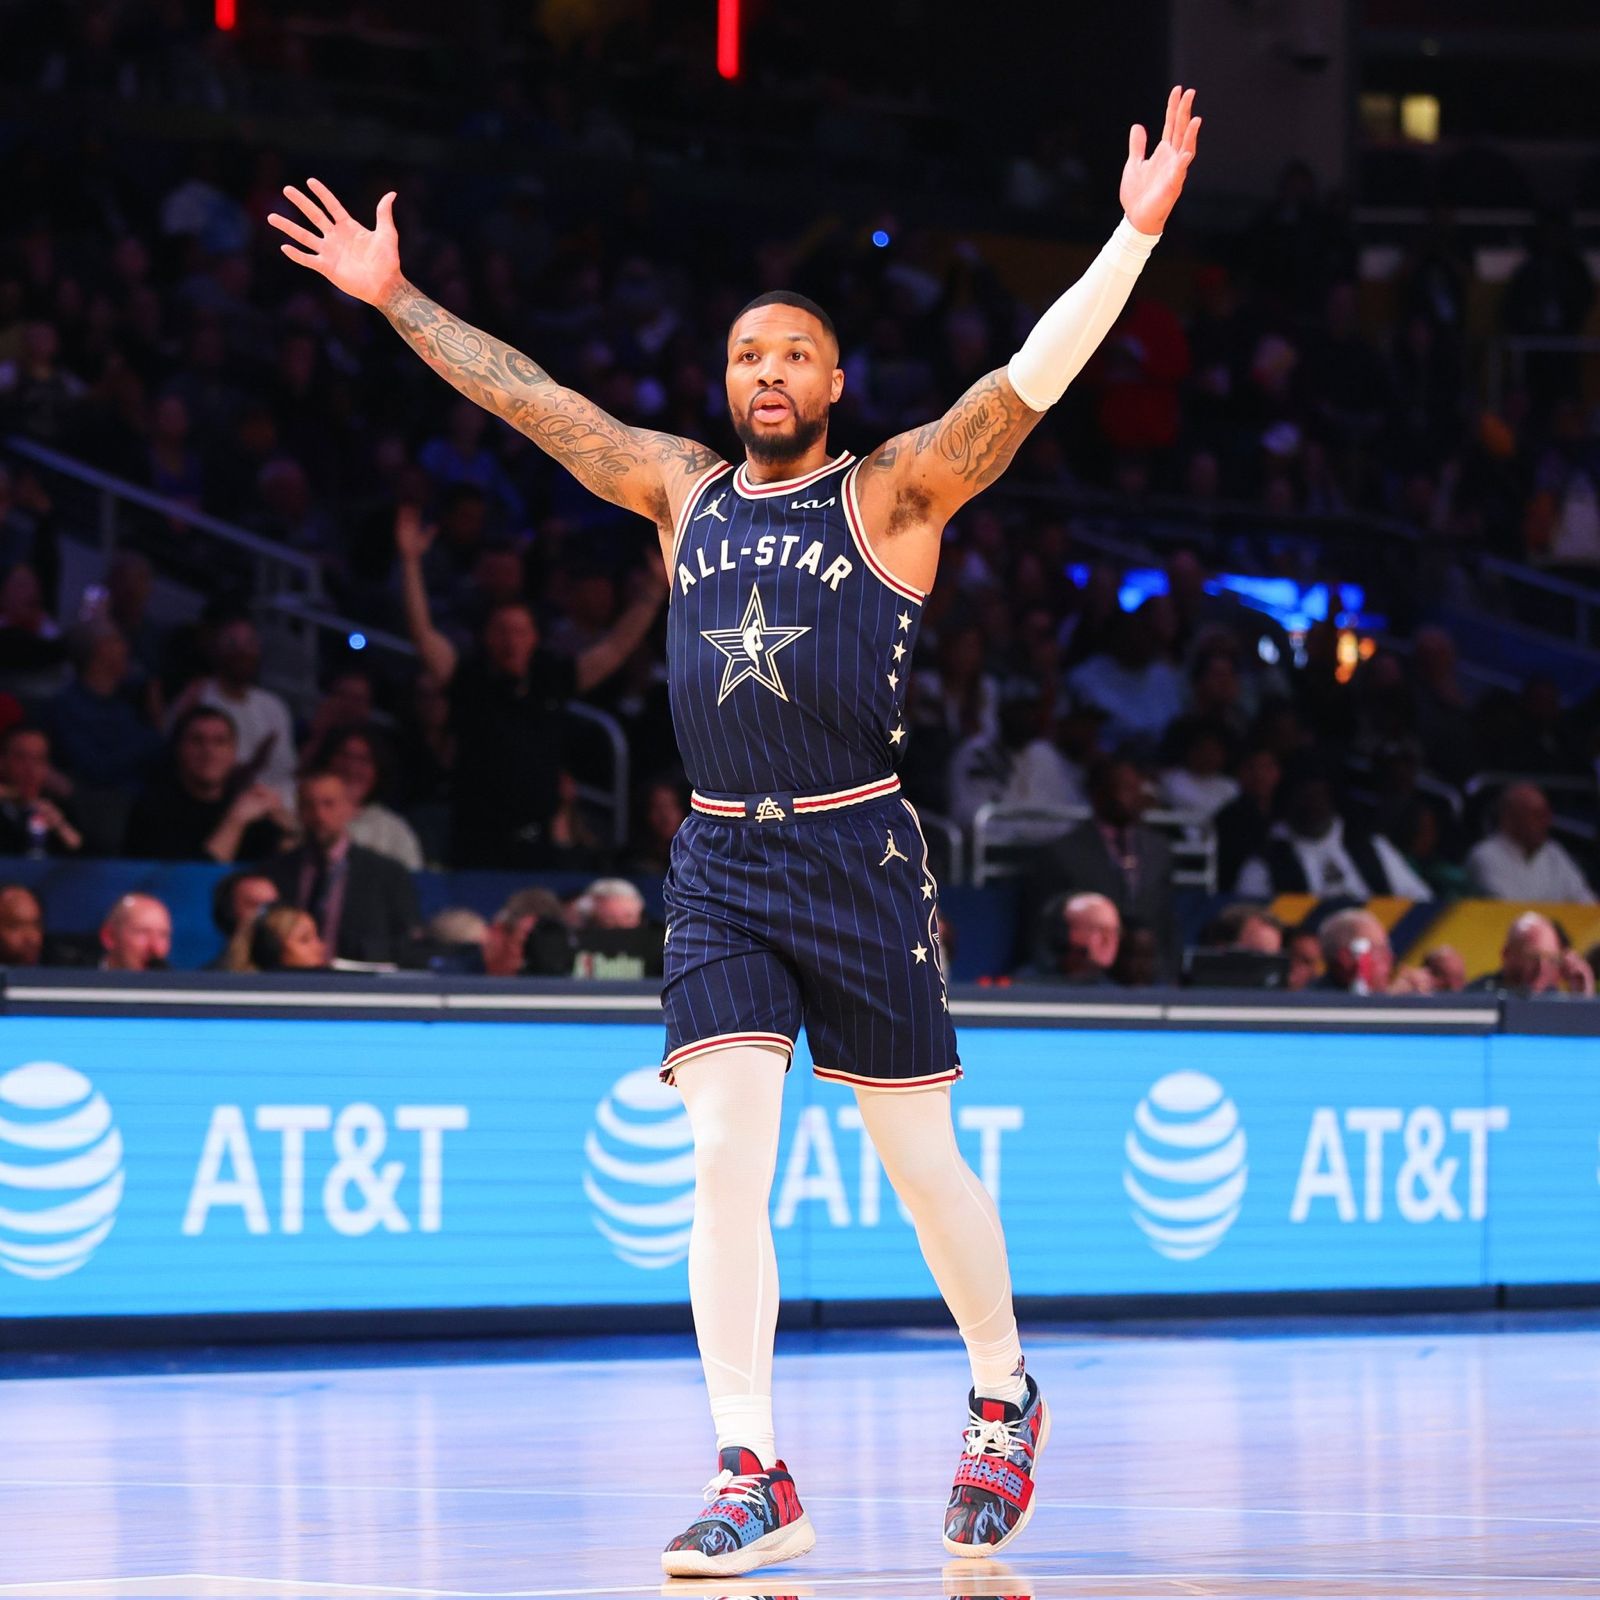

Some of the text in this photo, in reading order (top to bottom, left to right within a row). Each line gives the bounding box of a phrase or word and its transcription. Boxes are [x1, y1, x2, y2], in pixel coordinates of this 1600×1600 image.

[677, 534, 853, 596] ALL-STAR
[180, 1102, 469, 1237] AT&T
[774, 1105, 1025, 1228] ATT
[1289, 1106, 1510, 1224] AT&T
